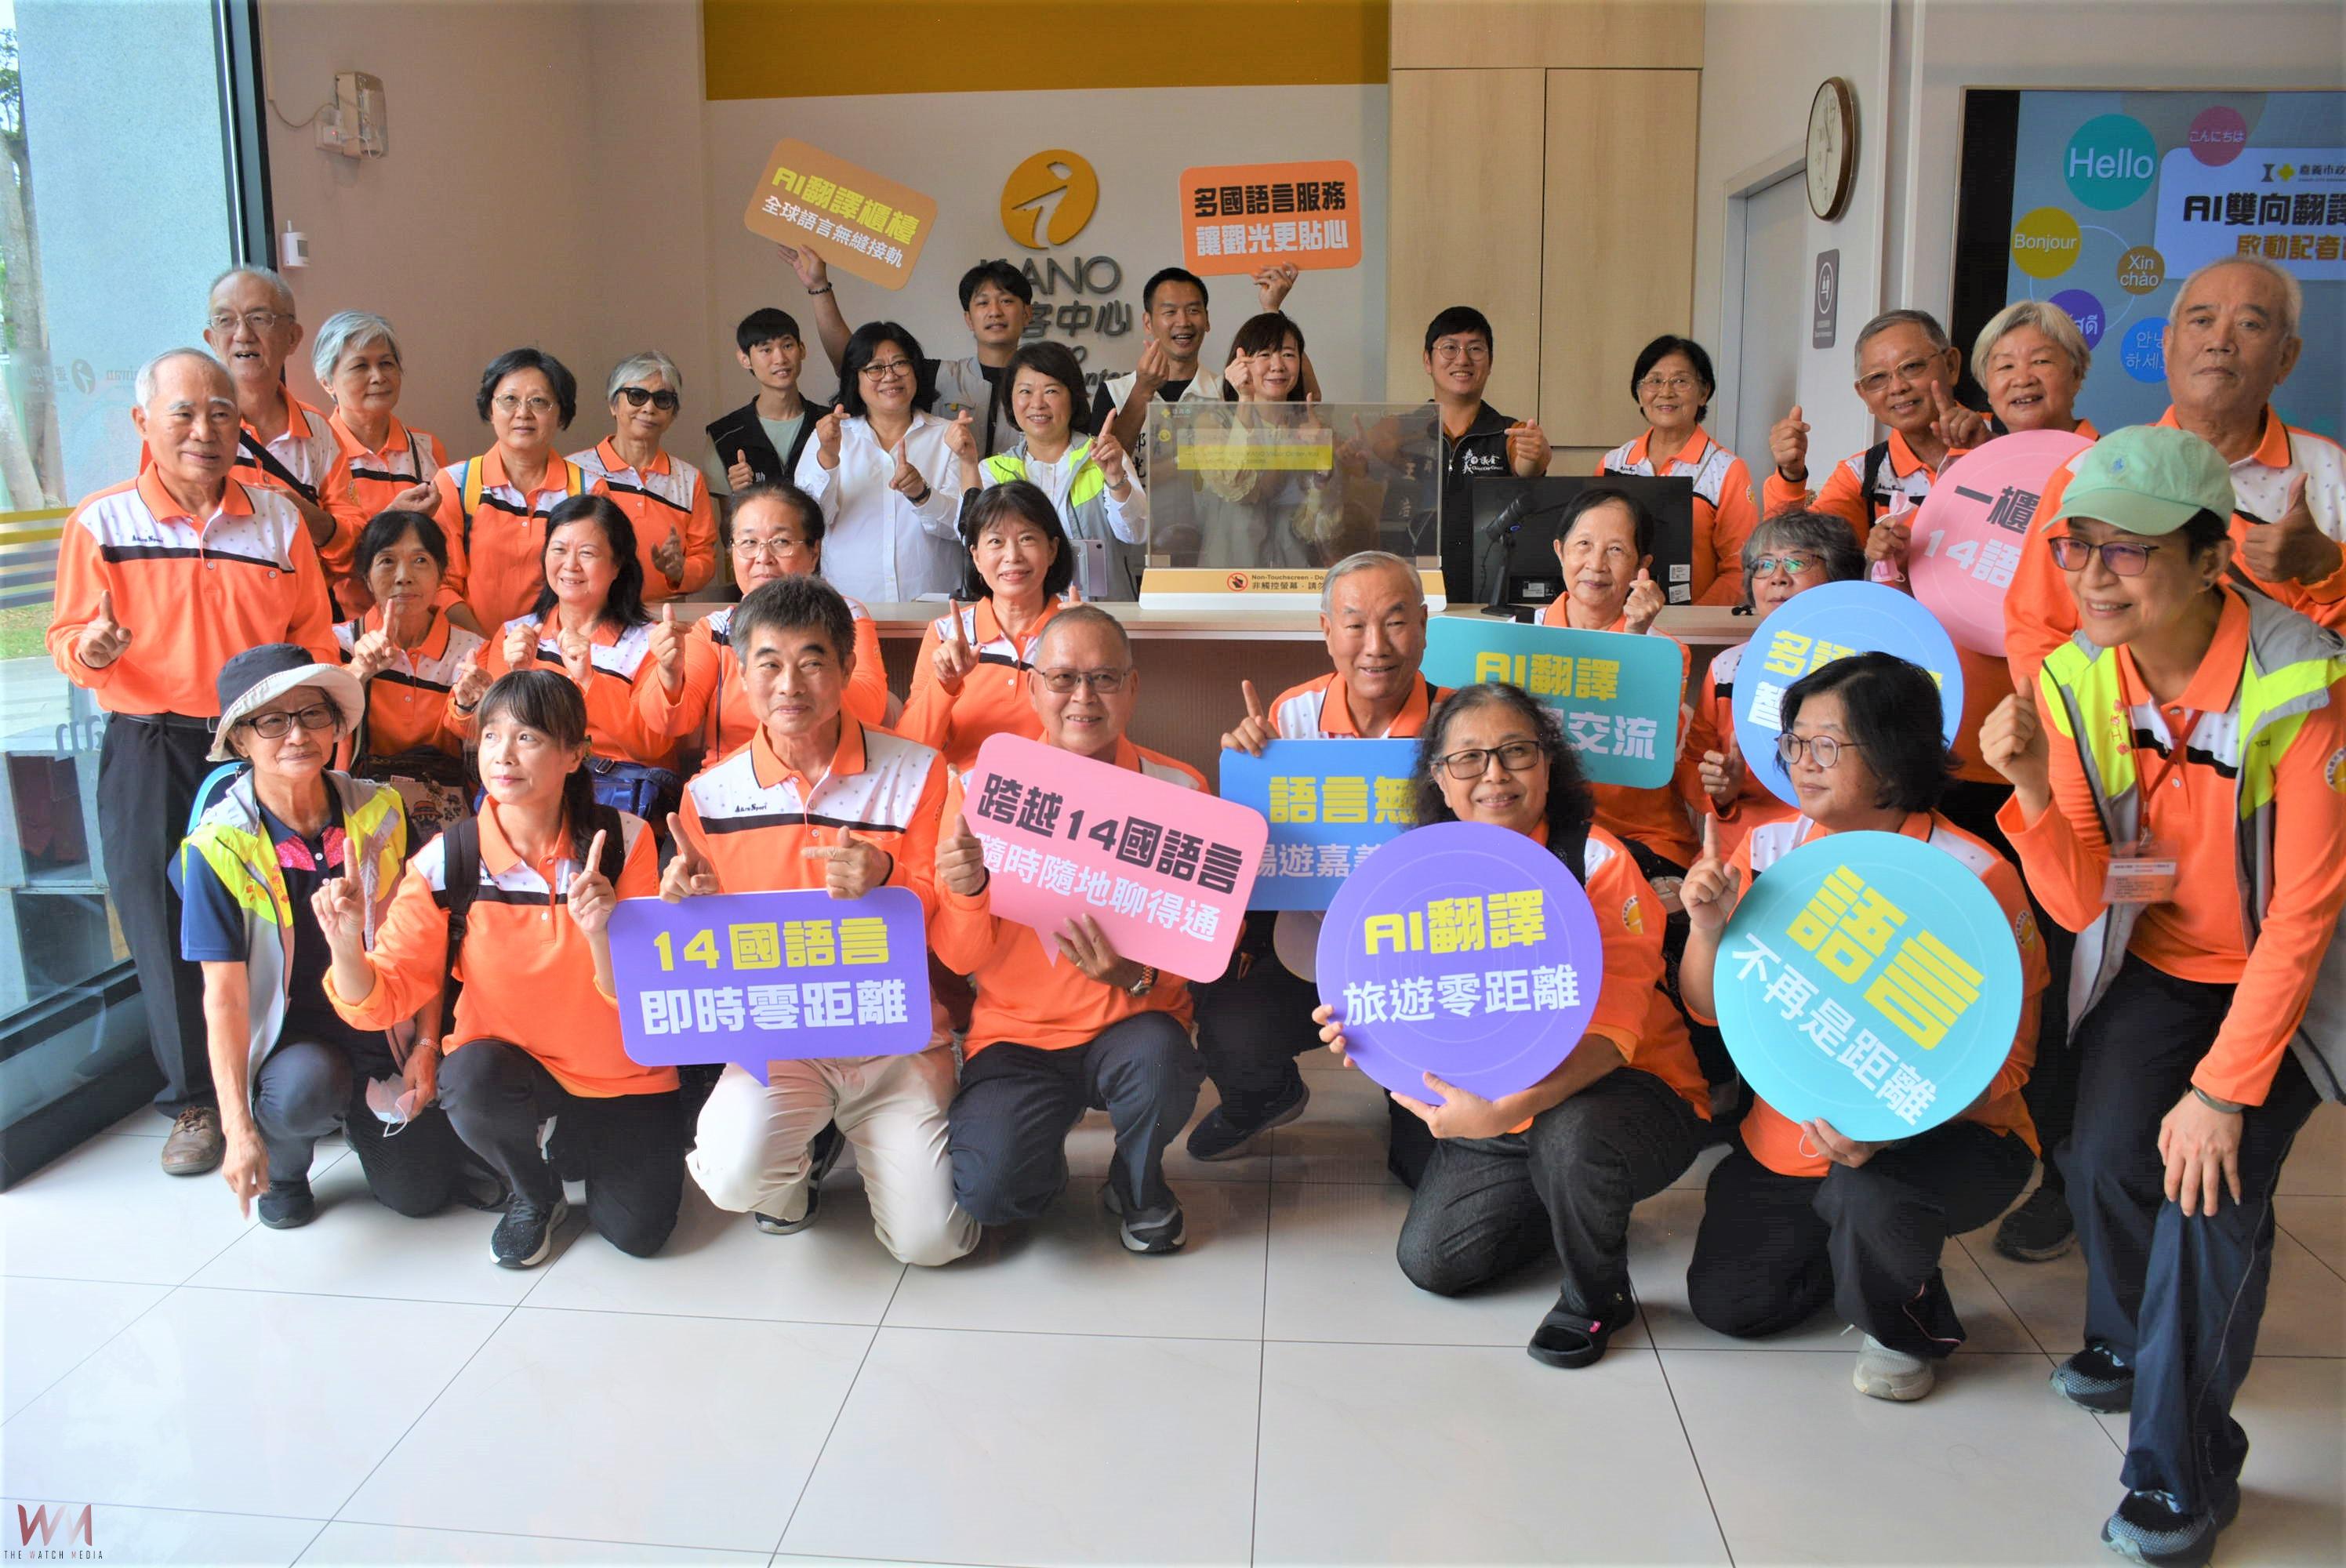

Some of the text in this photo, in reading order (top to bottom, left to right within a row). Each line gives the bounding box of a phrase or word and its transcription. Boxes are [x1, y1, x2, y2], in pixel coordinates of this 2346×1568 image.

[2189, 131, 2246, 143] こんにちは
[2069, 147, 2155, 179] Hello
[772, 167, 920, 245] AI翻譯櫃檯
[1194, 181, 1346, 218] 多國語言服務
[762, 195, 903, 268] 全球語言無縫接軌
[1196, 220, 1349, 256] 讓觀光更貼心
[2014, 234, 2076, 252] Bonjour
[2237, 234, 2346, 260] 啟動記者
[980, 256, 1122, 296] ANO
[2119, 272, 2159, 286] chào
[2128, 255, 2154, 270] Xin
[1475, 652, 1620, 701] AI翻譯
[977, 773, 1243, 895] 跨越14國語言
[653, 916, 889, 971] 14國語言
[1364, 889, 1546, 955] AI翻譯
[1785, 864, 1985, 1051] 語言
[640, 978, 908, 1035] 即時零距離
[1343, 964, 1581, 1026] 旅遊零距離
[1732, 932, 1937, 1126] 不再是距離
